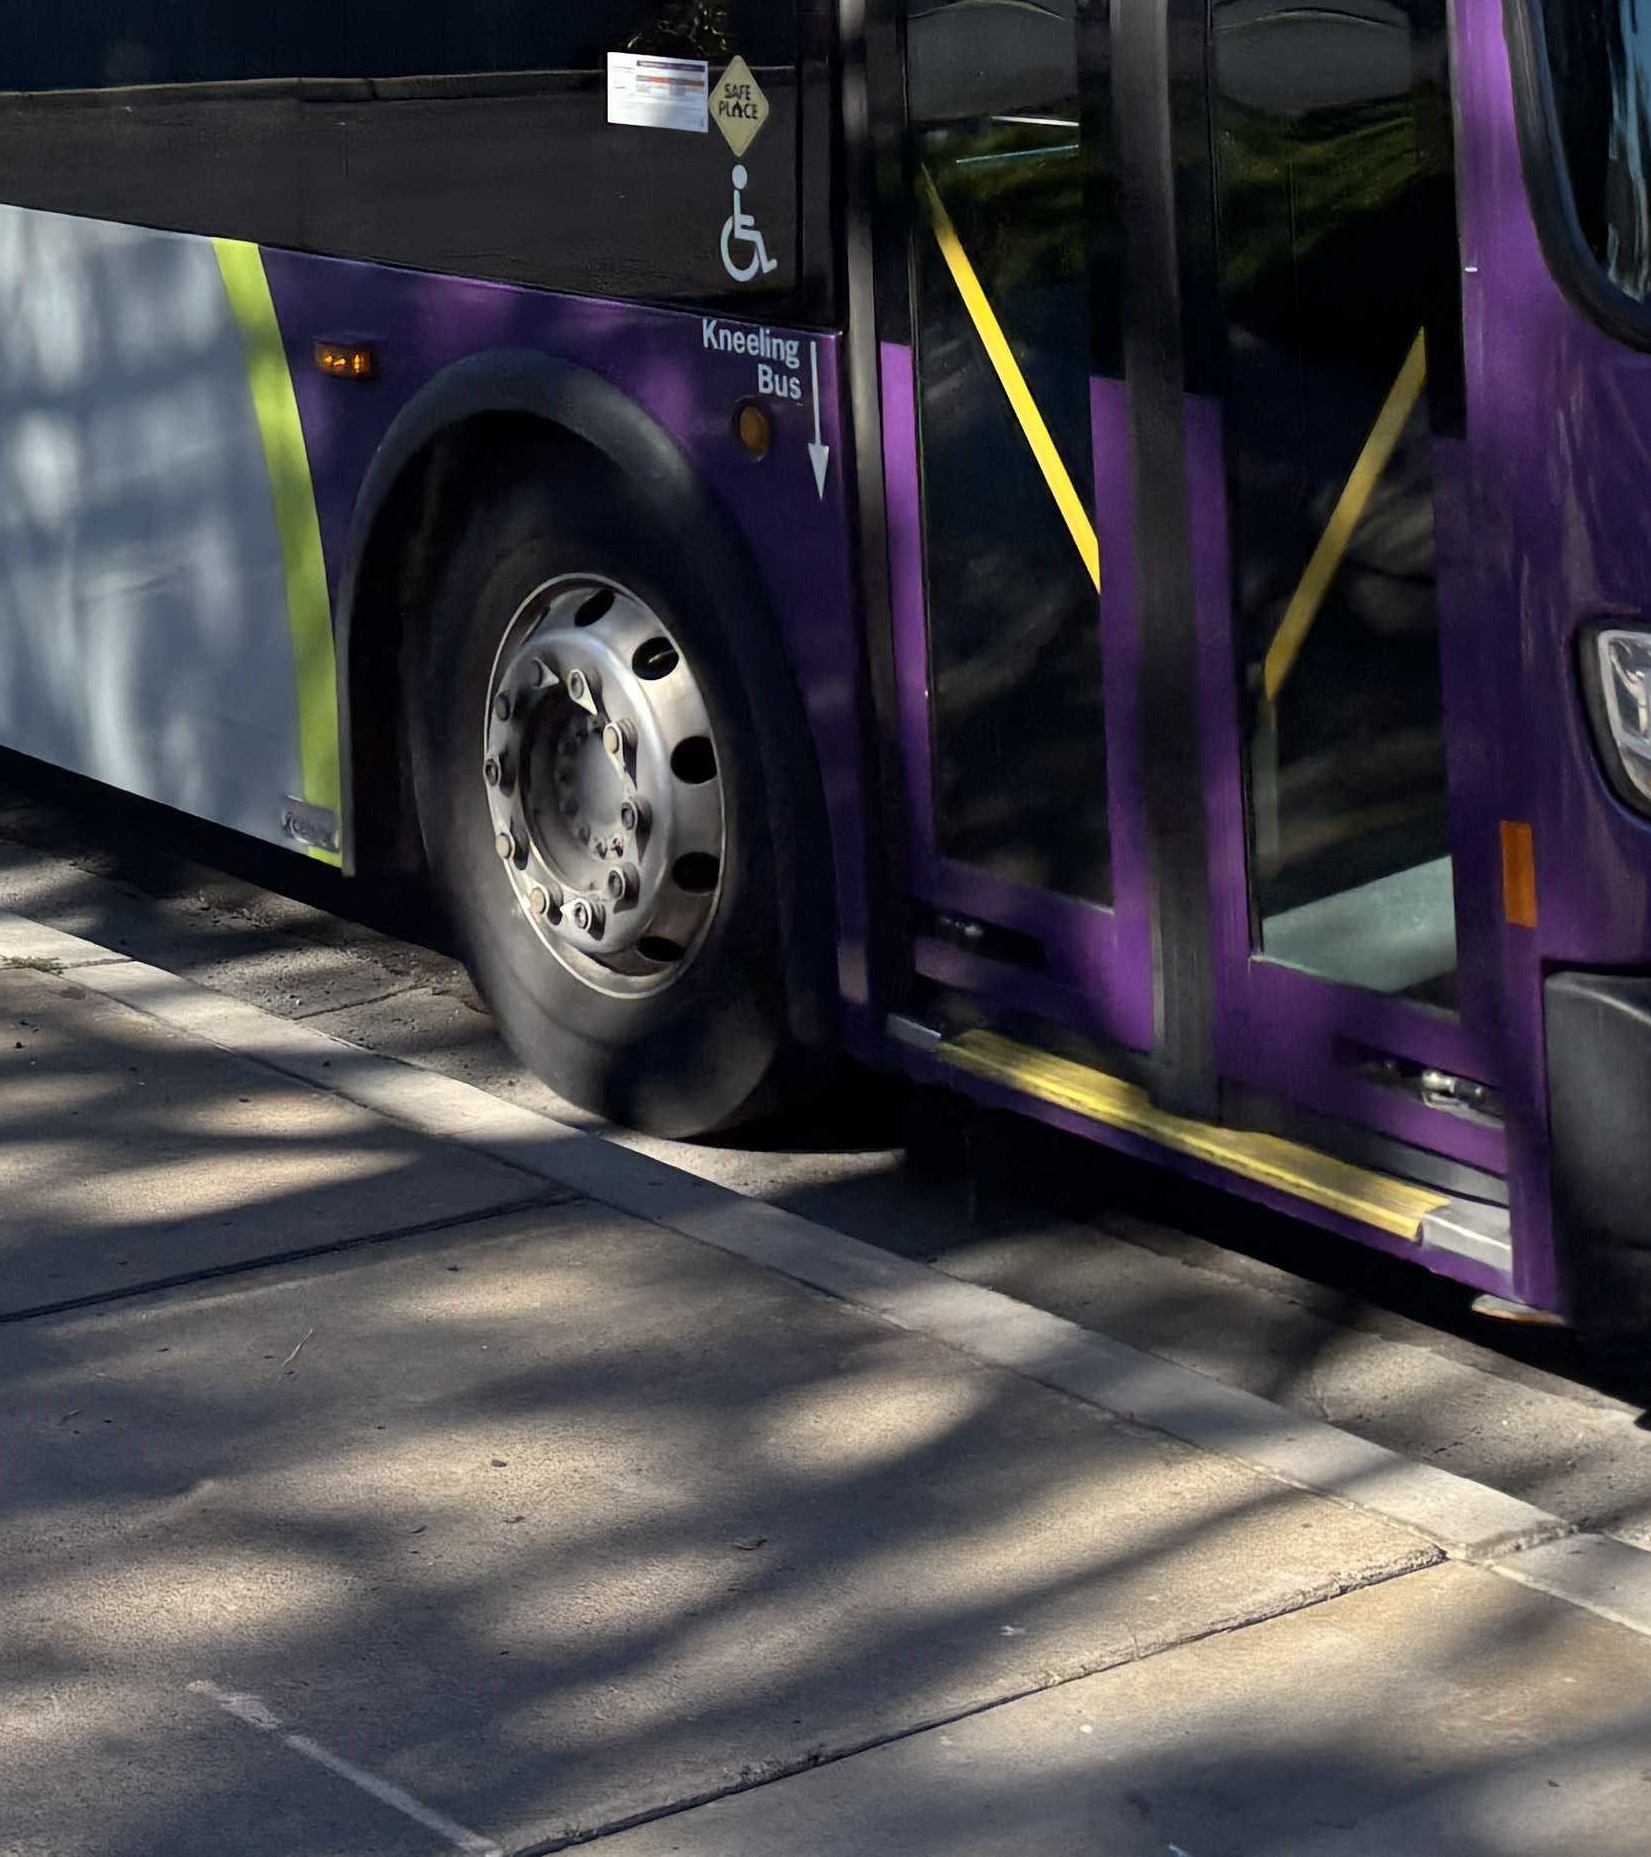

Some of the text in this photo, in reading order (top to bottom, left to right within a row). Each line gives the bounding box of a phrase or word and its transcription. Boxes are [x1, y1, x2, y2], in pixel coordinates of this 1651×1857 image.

[724, 83, 752, 100] SAFE
[718, 100, 758, 120] PLACE
[702, 318, 800, 370] Kneeling
[757, 363, 802, 400] Bus
